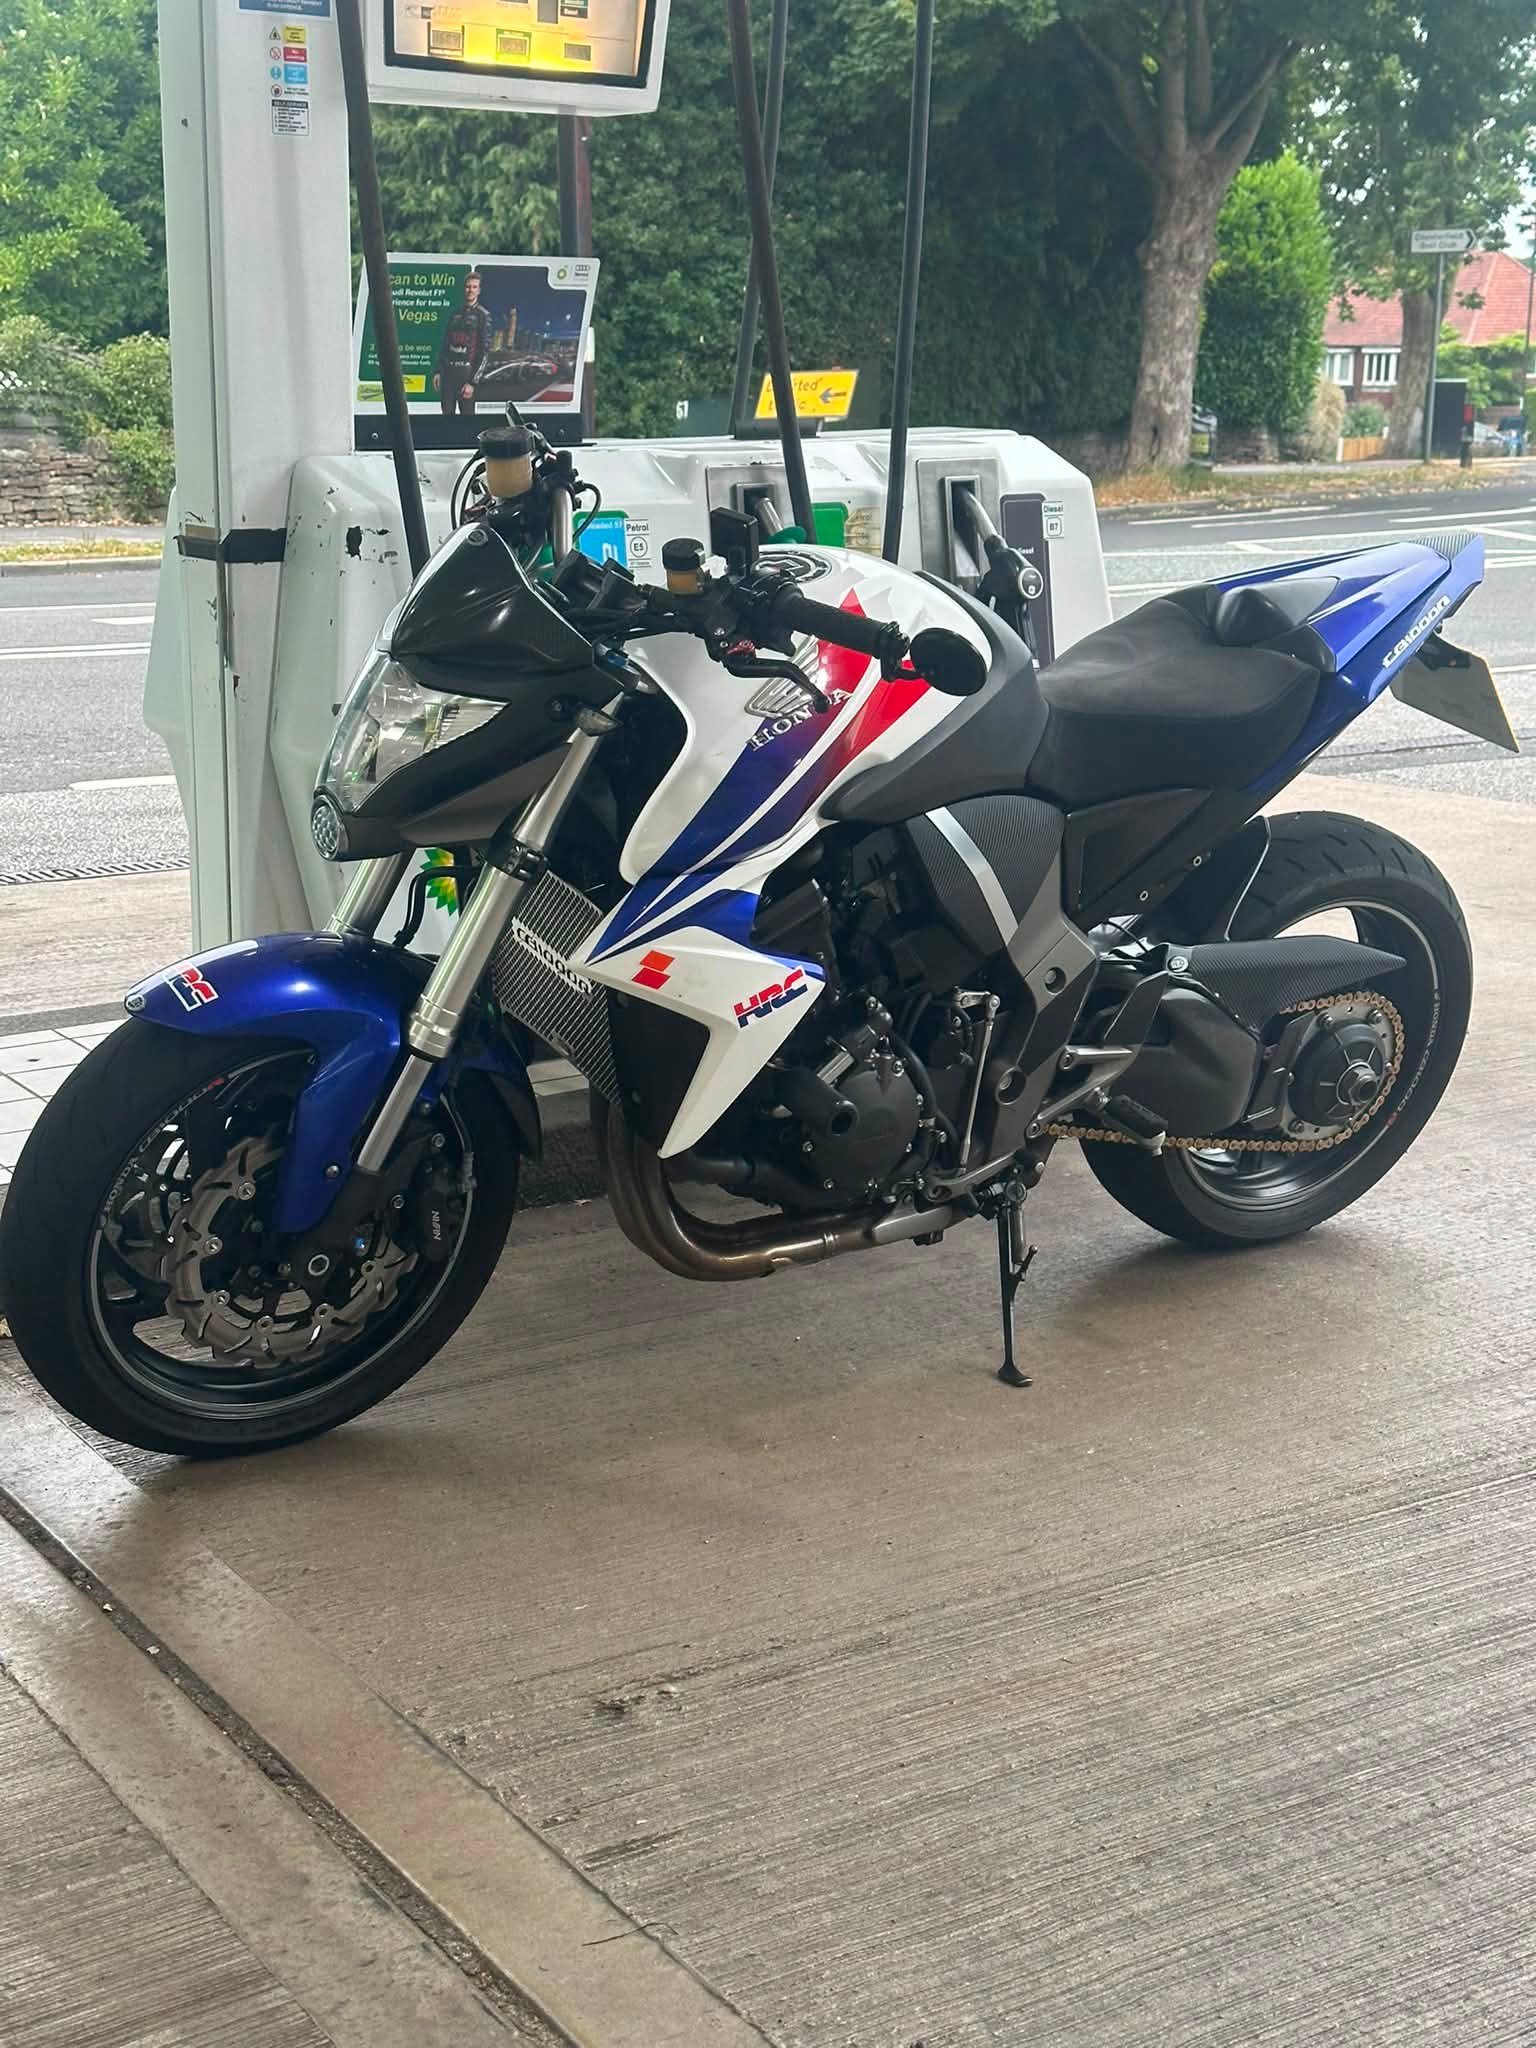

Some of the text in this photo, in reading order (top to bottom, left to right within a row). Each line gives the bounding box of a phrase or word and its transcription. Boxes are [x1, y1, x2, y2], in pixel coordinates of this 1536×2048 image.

[387, 273, 456, 286] can to Win
[392, 288, 404, 296] udi
[416, 298, 427, 306] for
[399, 309, 438, 324] Vegas
[1043, 505, 1063, 513] Diesel
[626, 523, 649, 531] Petrol
[1050, 523, 1058, 531] B7
[633, 543, 644, 551] E5
[751, 688, 853, 752] HONA
[733, 967, 809, 1029] HRC
